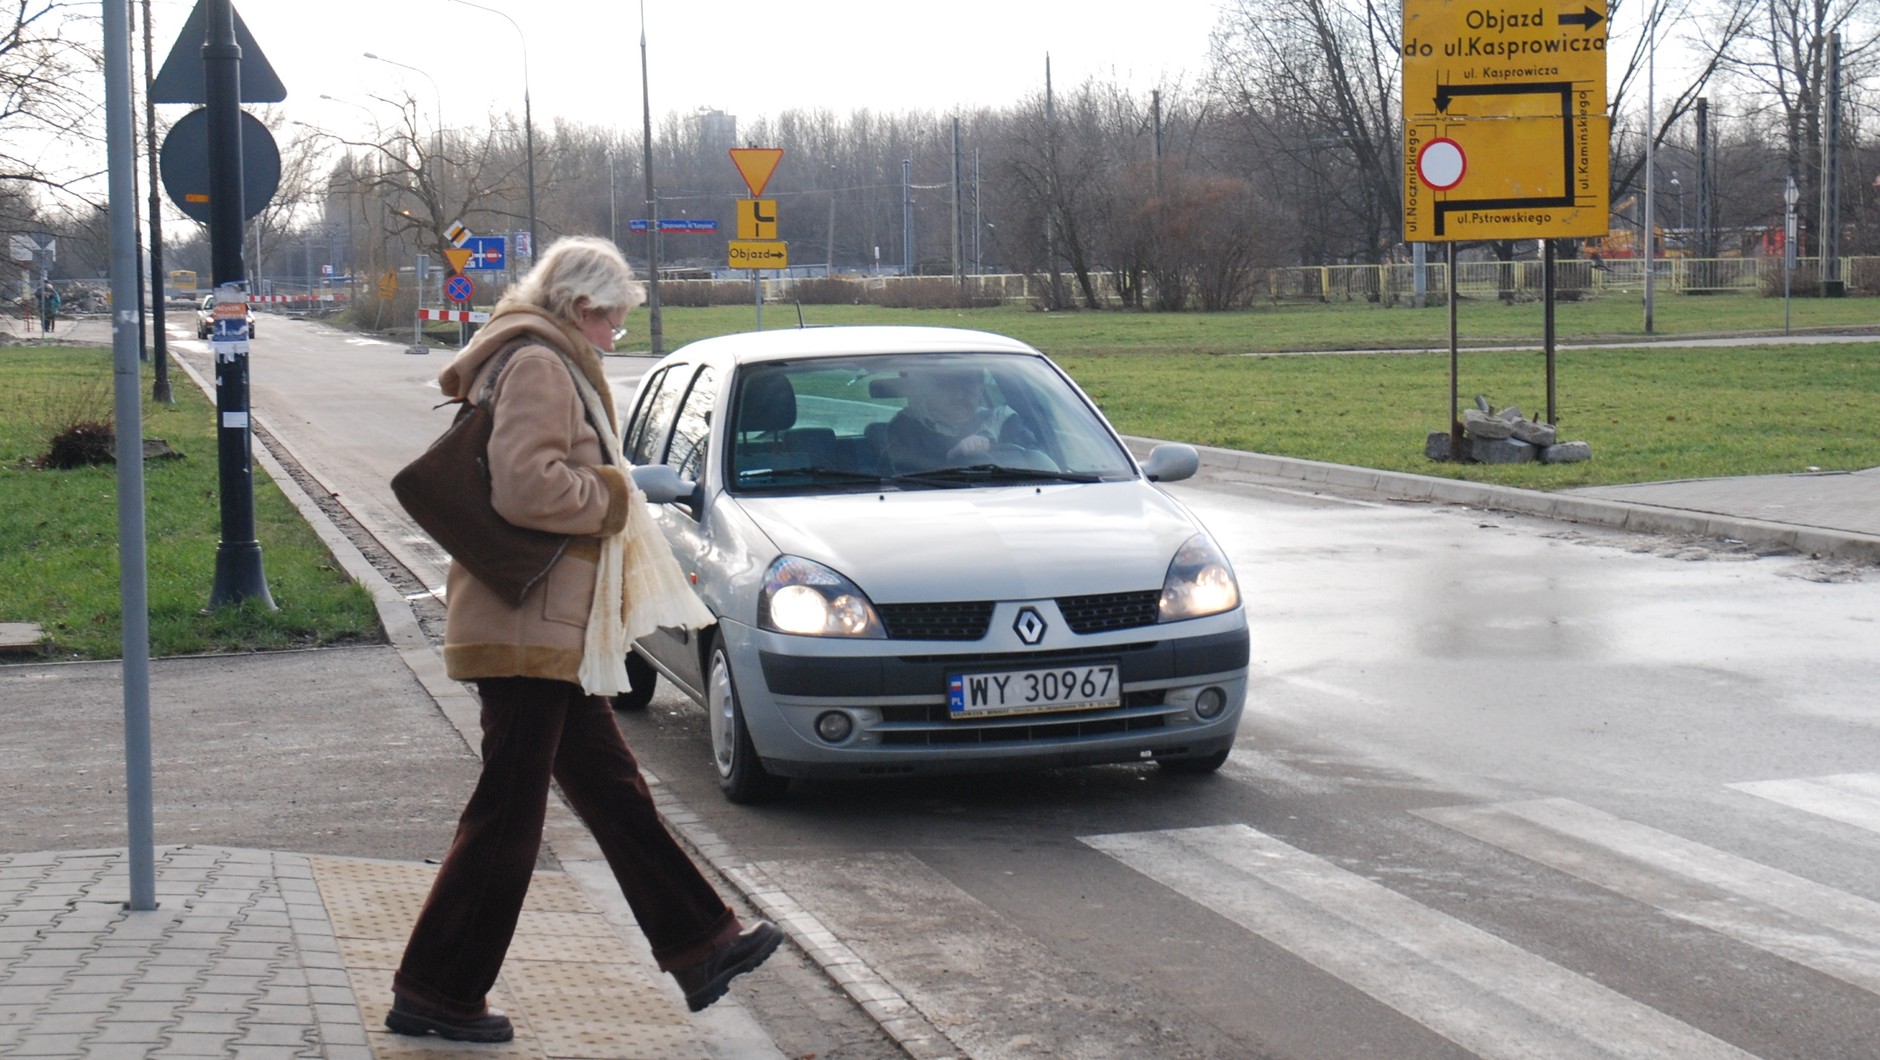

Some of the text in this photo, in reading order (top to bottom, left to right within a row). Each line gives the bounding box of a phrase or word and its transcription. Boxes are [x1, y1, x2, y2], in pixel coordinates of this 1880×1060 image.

[1466, 8, 1544, 33] Objazd
[1404, 34, 1605, 60] do ul.Kasprowicza
[1464, 66, 1559, 80] ul. Kasprowicza
[729, 248, 770, 261] Objazd
[969, 675, 1011, 706] WY
[1023, 668, 1114, 702] 30967
[951, 697, 963, 706] PL
